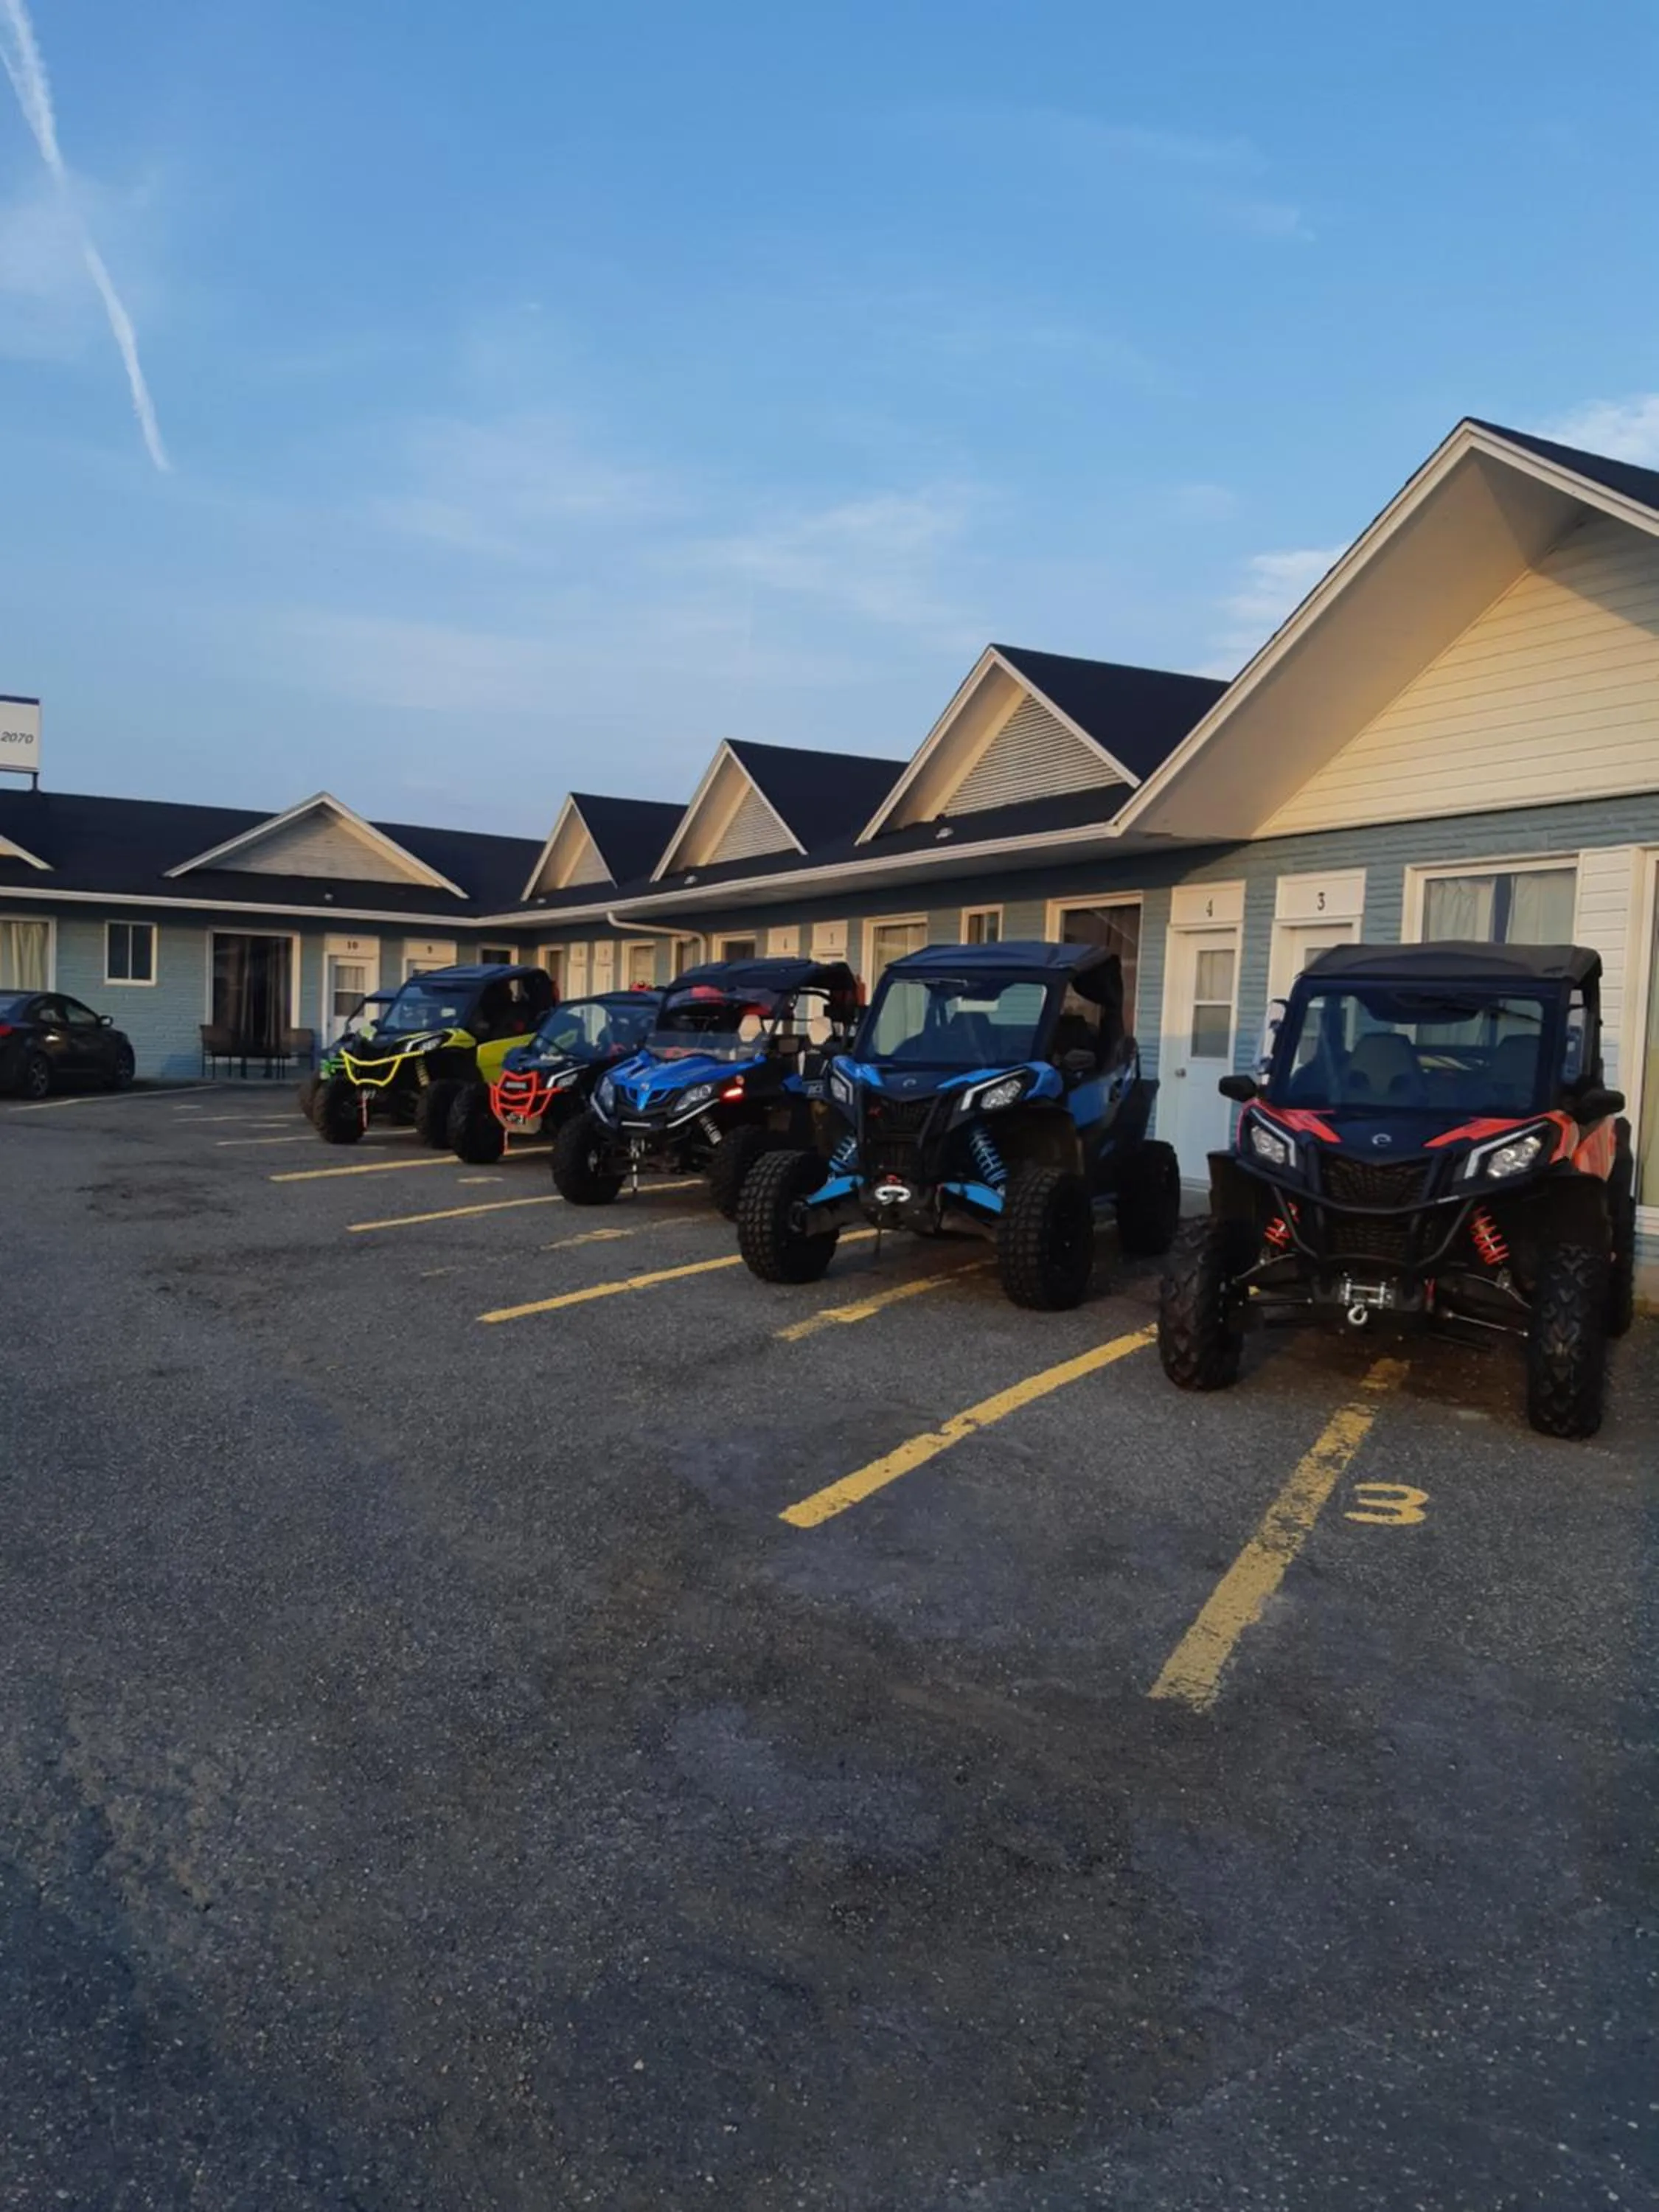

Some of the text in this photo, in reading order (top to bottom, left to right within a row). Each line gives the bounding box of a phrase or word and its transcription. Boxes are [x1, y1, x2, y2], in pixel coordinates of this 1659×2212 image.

[1, 731, 35, 744] 2070
[1317, 891, 1326, 911] 3
[347, 941, 358, 950] 10
[1343, 1483, 1429, 1526] 3
